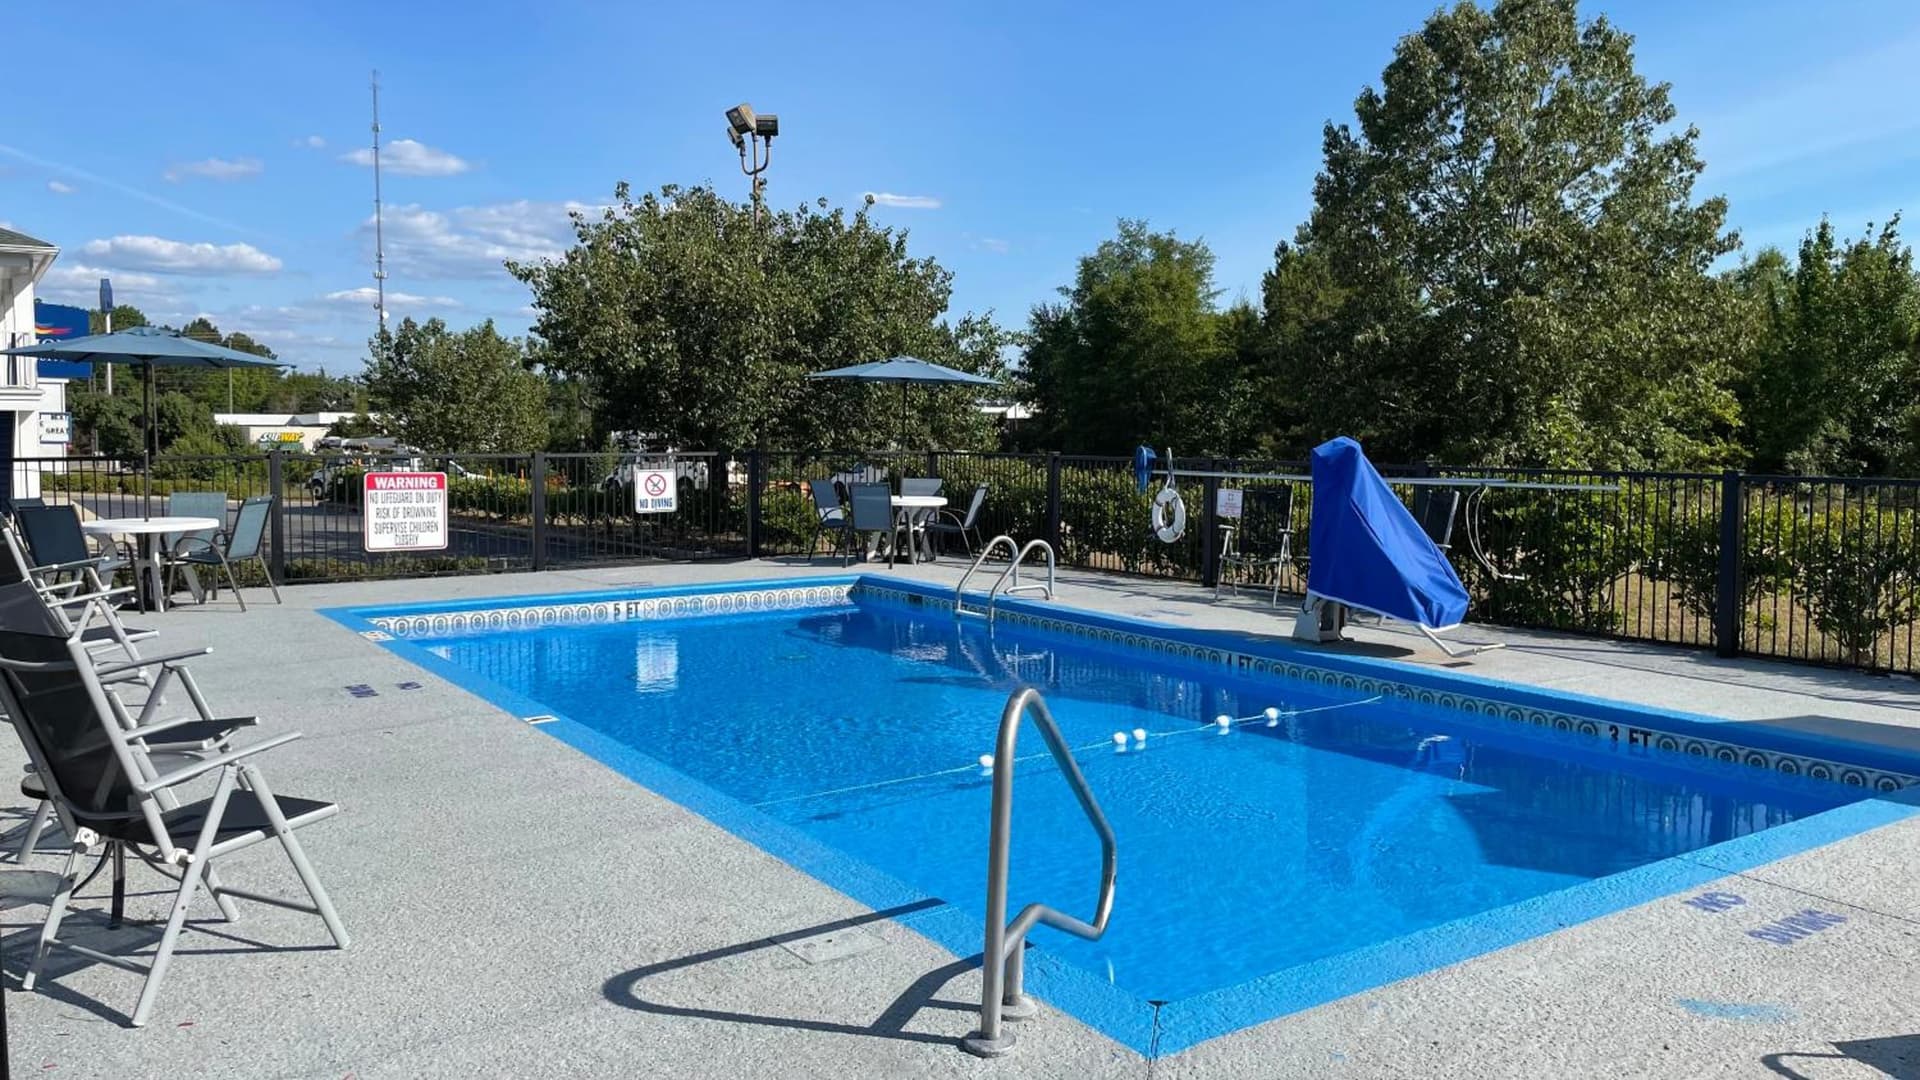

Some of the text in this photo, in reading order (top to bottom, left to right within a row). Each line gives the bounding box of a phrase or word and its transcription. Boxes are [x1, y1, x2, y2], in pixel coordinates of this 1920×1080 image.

[374, 477, 438, 489] WARNING
[369, 491, 442, 504] NO LIFEGUARD ON DUTY
[639, 497, 673, 509] NO DIVING
[375, 506, 437, 519] RISK OF DROWNING
[374, 521, 439, 534] SUPERVISE CHILDREN
[394, 534, 419, 546] CLOSELY
[626, 601, 641, 619] FT
[1628, 727, 1652, 747] FT
